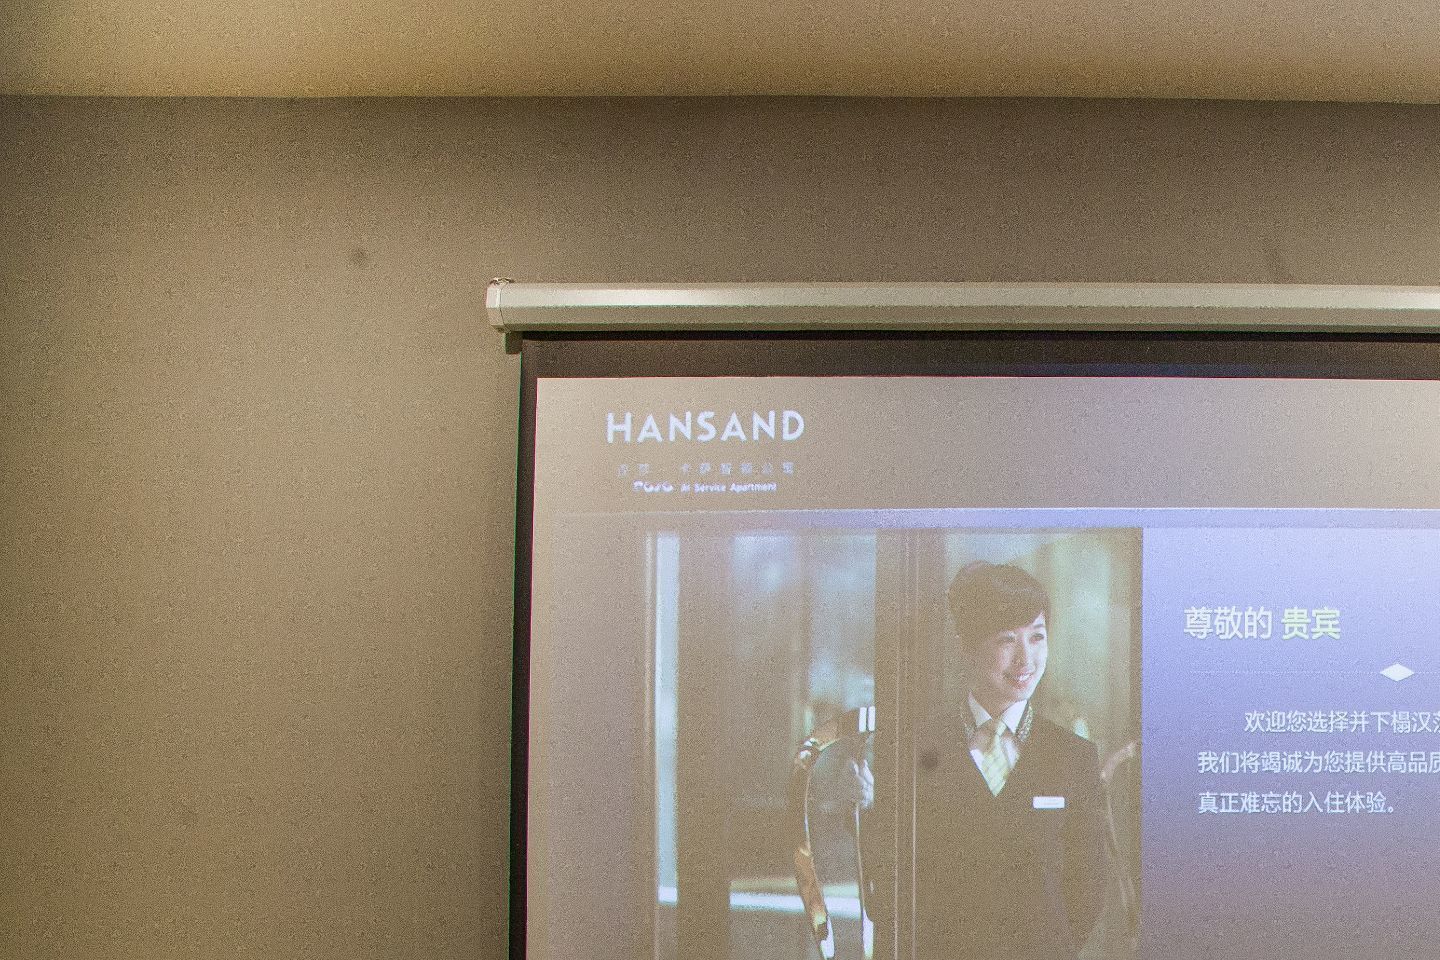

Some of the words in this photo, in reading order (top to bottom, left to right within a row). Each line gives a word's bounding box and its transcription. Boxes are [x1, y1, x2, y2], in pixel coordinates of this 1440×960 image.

[606, 410, 805, 444] HANSAND
[694, 482, 726, 493] Service
[730, 482, 777, 493] Apartment
[1183, 605, 1273, 640] 尊敬的
[1281, 606, 1342, 640] 贵宾
